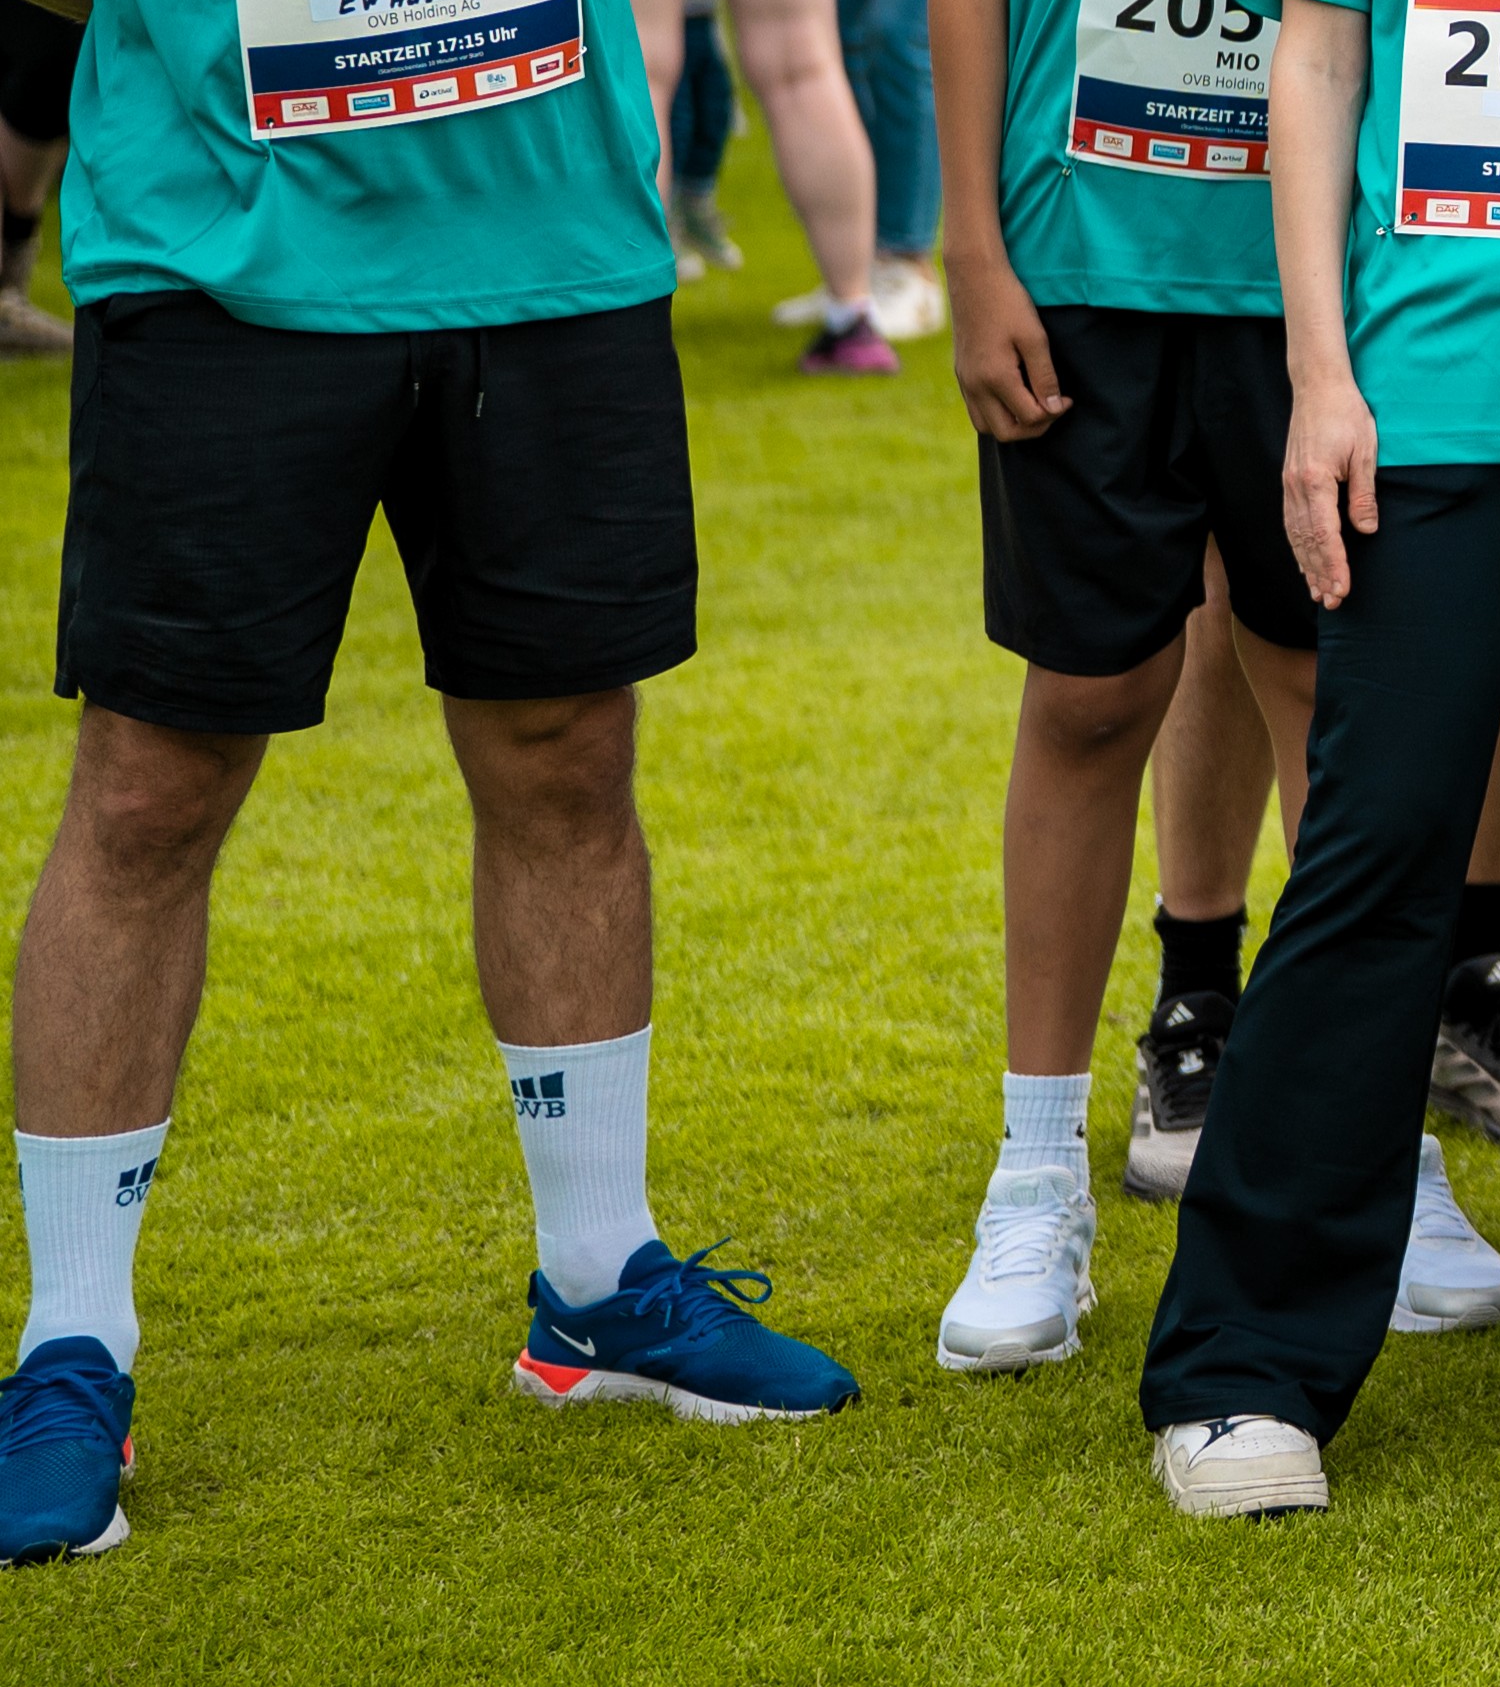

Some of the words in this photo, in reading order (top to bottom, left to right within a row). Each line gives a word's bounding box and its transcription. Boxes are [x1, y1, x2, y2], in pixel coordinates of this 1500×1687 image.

[367, 11, 399, 29] OVB
[403, 2, 457, 25] Holding
[335, 42, 432, 70] STARTZEIT
[437, 32, 485, 54] 17:15
[489, 27, 518, 44] Uhr
[1216, 50, 1260, 71] MIO
[1182, 73, 1211, 87] OVB
[1215, 75, 1265, 93] Holding
[1146, 102, 1234, 124] STARTZEIT
[116, 1186, 149, 1207] OV
